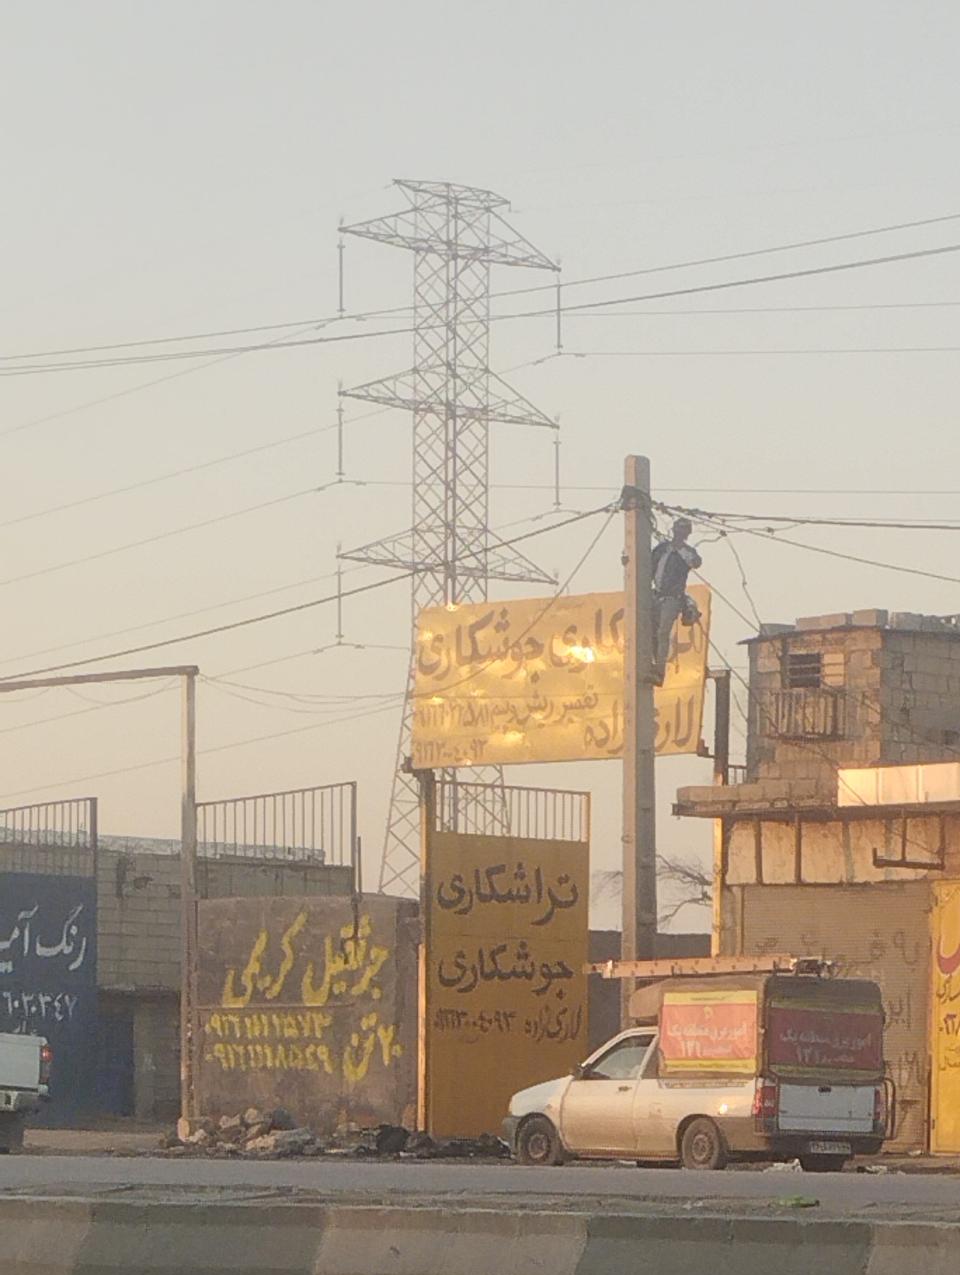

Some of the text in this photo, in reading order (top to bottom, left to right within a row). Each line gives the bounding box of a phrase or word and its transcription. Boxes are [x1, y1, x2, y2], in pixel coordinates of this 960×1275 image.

[418, 608, 546, 684] جوشکاری
[438, 863, 579, 926] تراشکاری
[36, 903, 86, 971] رنگ
[438, 941, 573, 1000] جوشکاری
